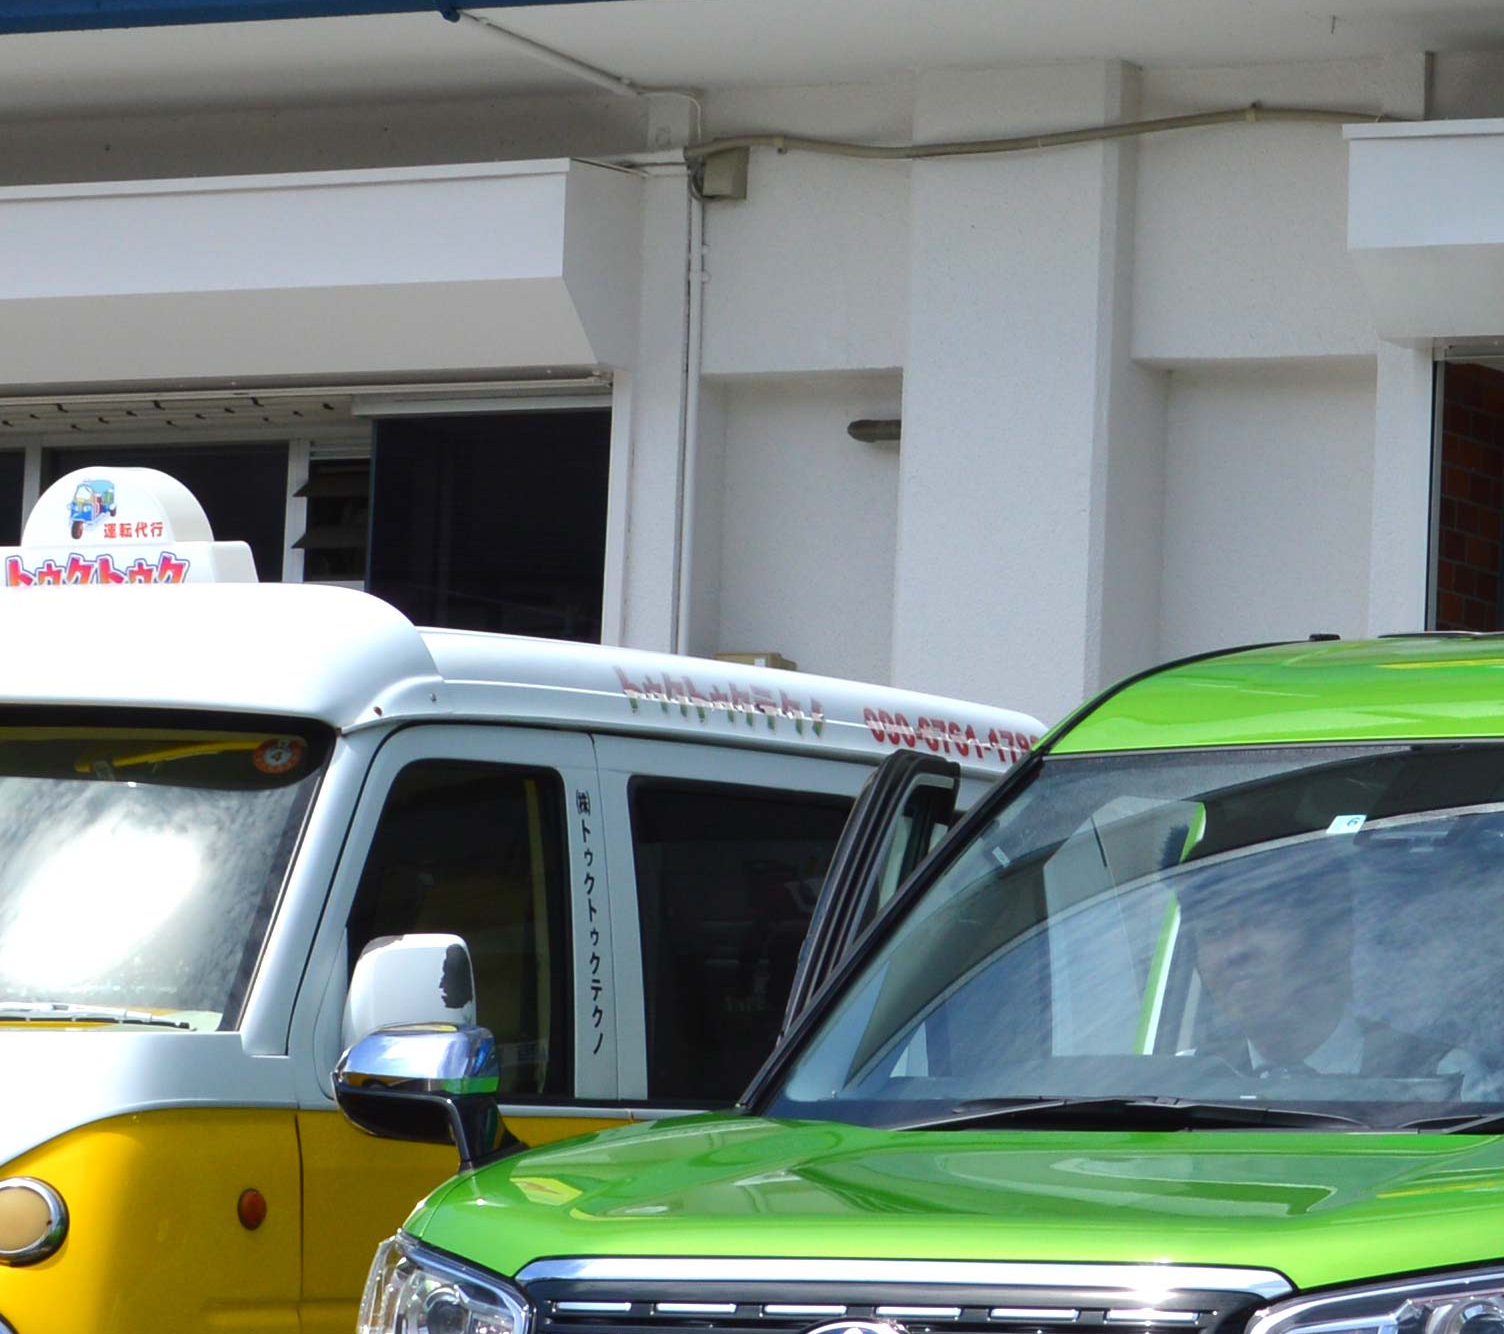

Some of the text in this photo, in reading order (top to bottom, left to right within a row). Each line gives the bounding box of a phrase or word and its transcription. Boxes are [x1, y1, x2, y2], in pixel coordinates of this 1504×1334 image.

[102, 521, 164, 540] 運転代行
[863, 706, 1040, 765] 090-6761-178
